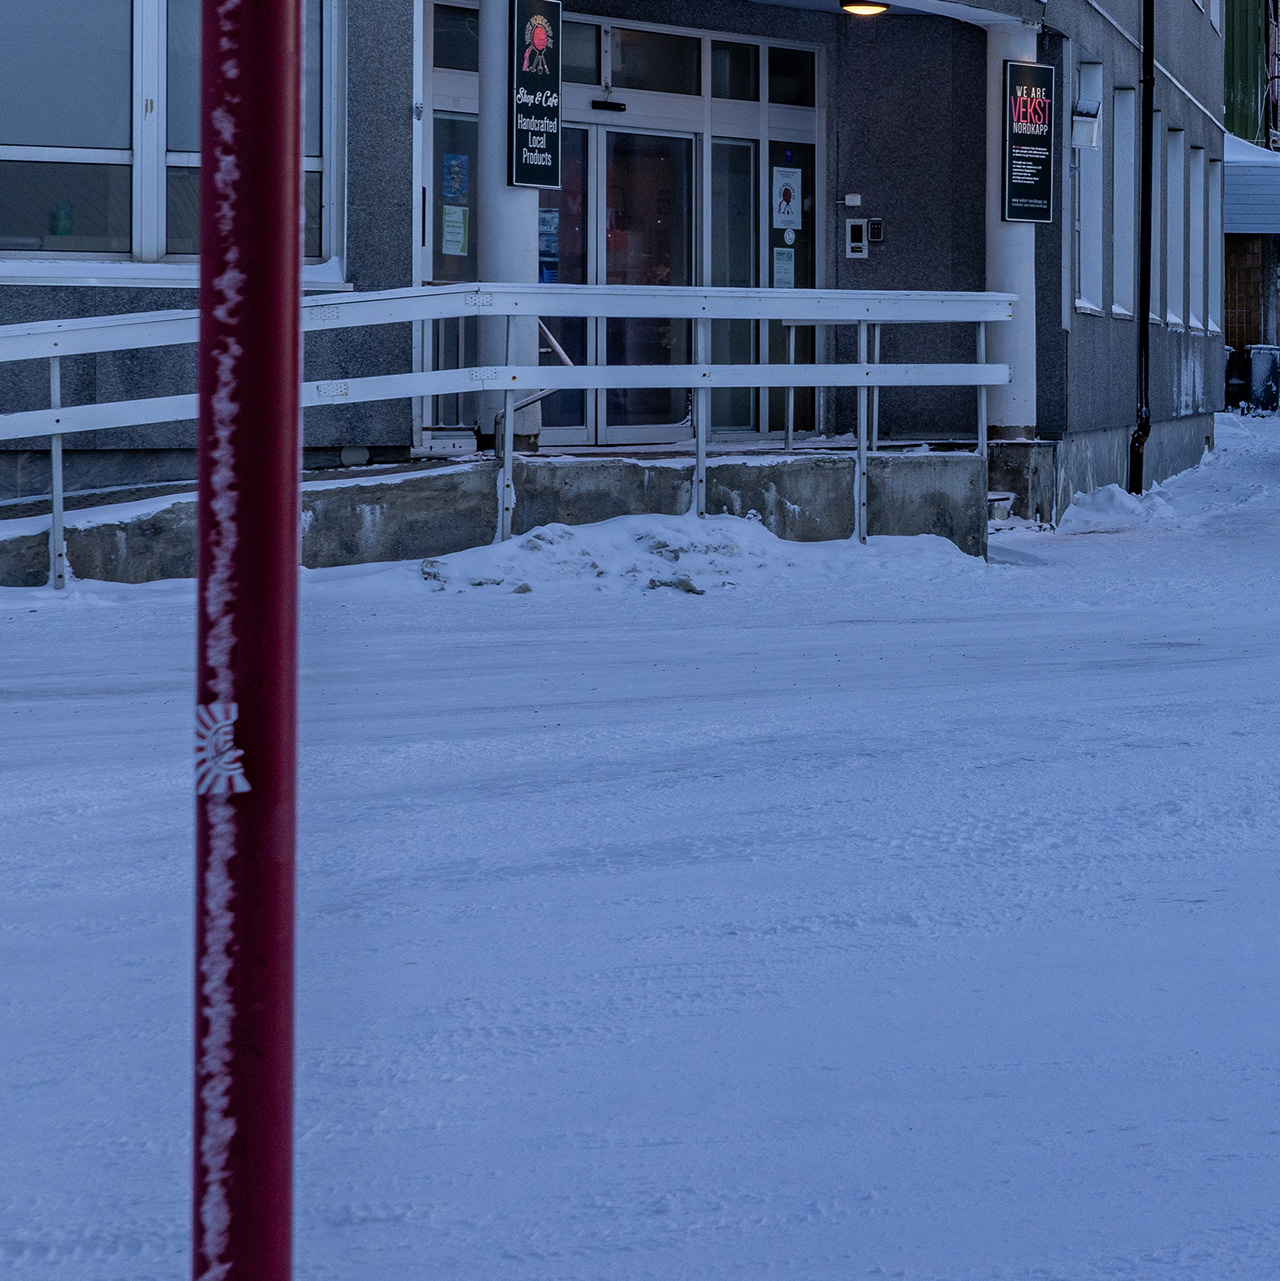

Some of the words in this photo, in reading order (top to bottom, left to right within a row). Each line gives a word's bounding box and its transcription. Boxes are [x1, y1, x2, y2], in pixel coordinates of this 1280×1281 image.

[516, 87, 534, 107] Shop
[535, 91, 542, 105] &
[1015, 86, 1027, 97] WE
[1031, 87, 1046, 99] ARE
[1010, 96, 1051, 125] VEKST
[517, 113, 558, 133] Handcrafted
[1012, 122, 1049, 136] NORDKAPP
[528, 131, 547, 149] Local
[522, 147, 552, 166] Products
